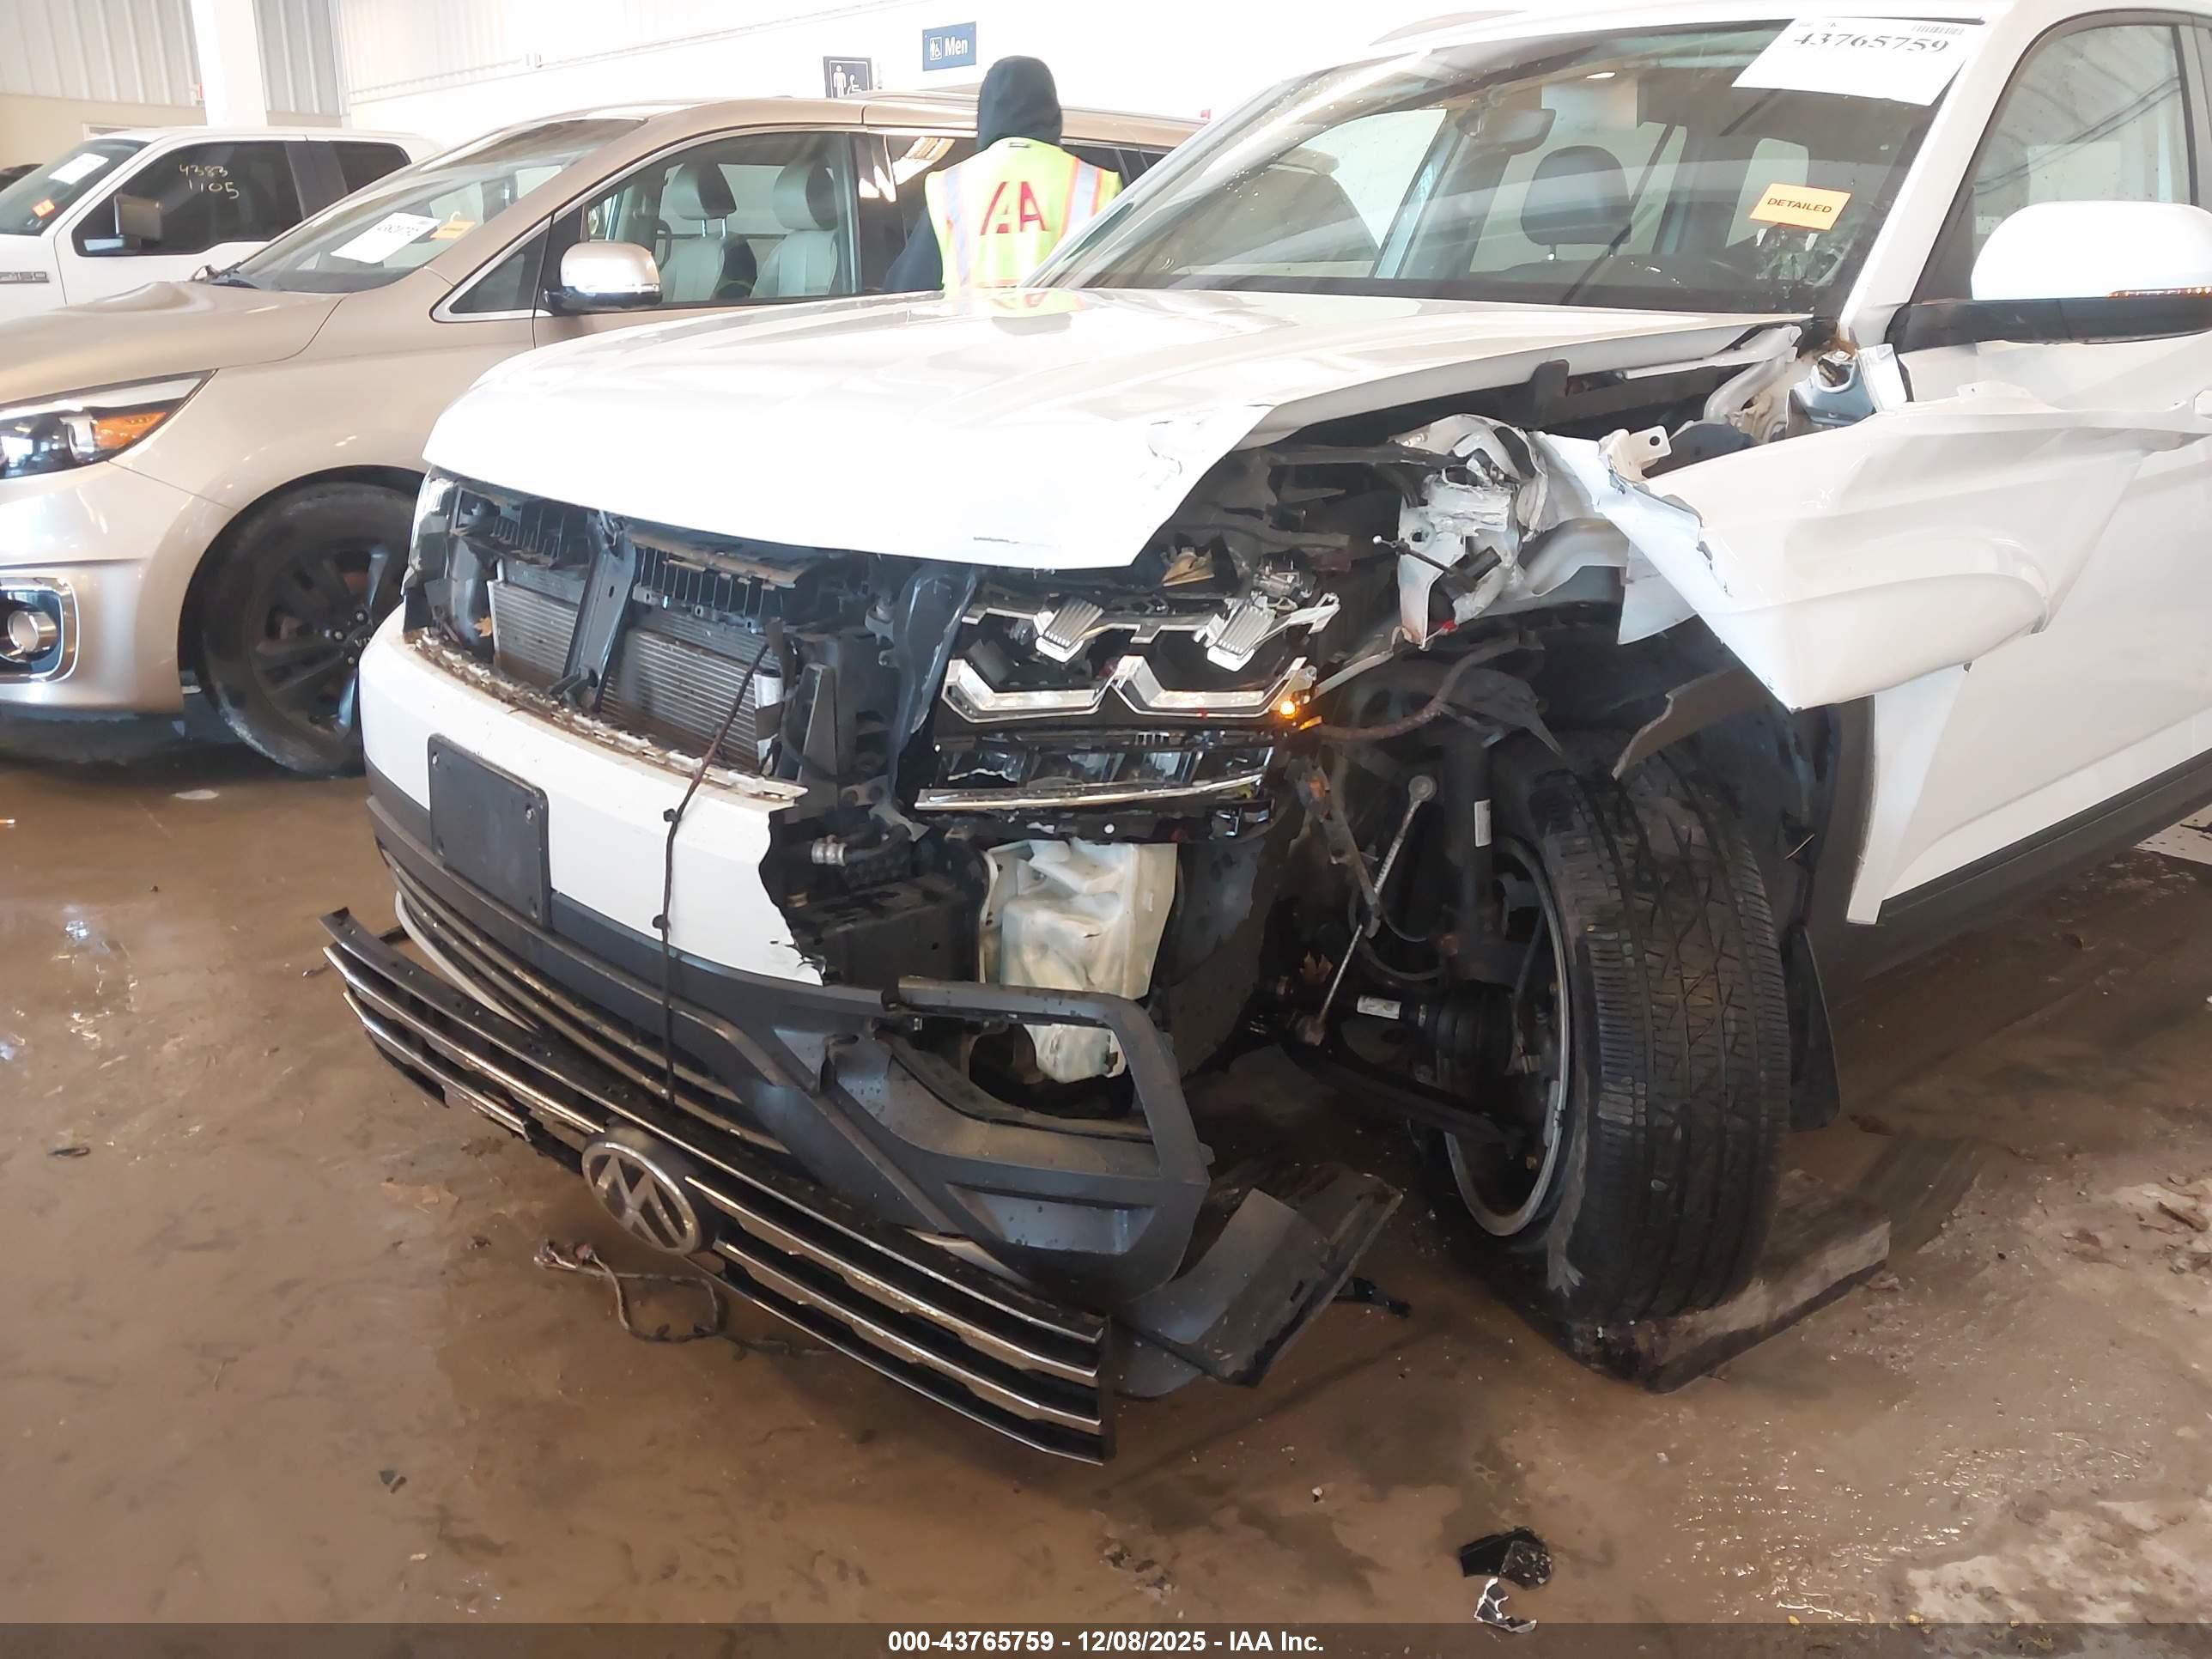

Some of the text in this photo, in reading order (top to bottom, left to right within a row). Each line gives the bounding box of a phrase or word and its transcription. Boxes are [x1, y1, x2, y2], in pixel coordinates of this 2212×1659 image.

[945, 36, 969, 57] Men
[1794, 32, 1949, 52] 43765759
[189, 179, 240, 199] 1105
[1766, 198, 1832, 214] DETAILED
